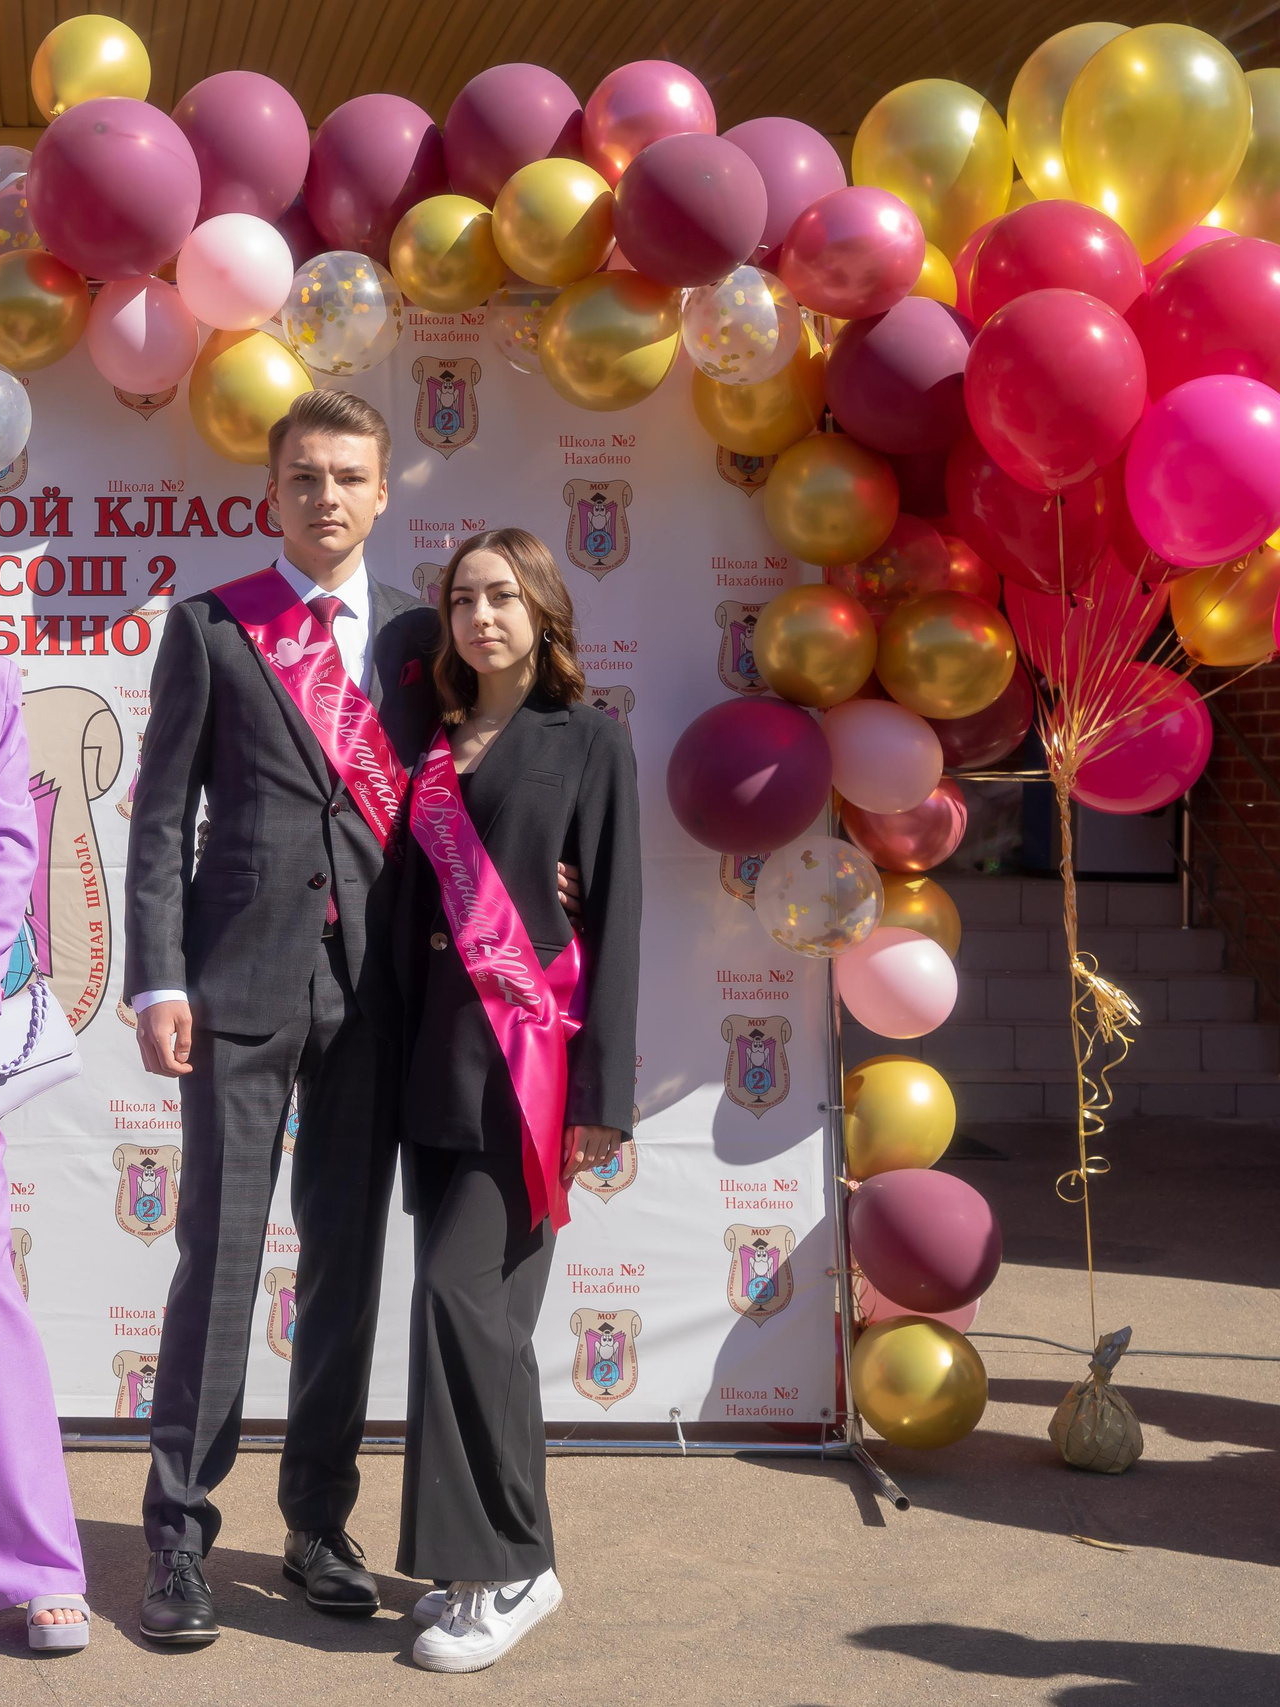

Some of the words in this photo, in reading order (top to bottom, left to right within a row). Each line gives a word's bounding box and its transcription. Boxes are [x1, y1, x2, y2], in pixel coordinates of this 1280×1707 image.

[408, 313, 455, 325] Школа
[460, 313, 485, 325] №2
[414, 330, 480, 342] Нахабино
[441, 412, 454, 430] 2
[558, 435, 607, 449] Школа
[611, 434, 636, 448] №2
[564, 453, 631, 466] Нахабино
[108, 480, 155, 492] Школа
[160, 479, 185, 492] №2
[589, 483, 610, 491] МОУ
[408, 519, 455, 531] Школа
[461, 519, 486, 531] №2
[593, 534, 606, 552] 2
[711, 557, 758, 570] Школа
[764, 556, 788, 570] №2
[147, 555, 176, 597] 2
[716, 574, 784, 587] Нахабино
[576, 643, 607, 653] кола
[612, 640, 638, 653] №2
[579, 658, 633, 670] ахабино
[354, 781, 389, 837] Нахабинская
[73, 832, 101, 910] ШКОЛА
[747, 862, 759, 881] 2
[415, 786, 500, 943] Выпускница
[480, 945, 542, 1006] 2022
[716, 970, 763, 983] Школа
[768, 970, 794, 982] №2
[722, 987, 789, 1001] Нахабино
[747, 1019, 768, 1027] МОУ
[752, 1071, 765, 1089] 2
[110, 1099, 156, 1112] Школа
[115, 1117, 182, 1130] Нахабино
[139, 1148, 160, 1156] МОУ
[10, 1182, 36, 1195] №2
[719, 1179, 768, 1192] Школа
[773, 1179, 799, 1192] №2
[142, 1199, 155, 1218] 2
[725, 1197, 794, 1210] Нахабино
[266, 1223, 299, 1236] Школ
[266, 1240, 300, 1253] Наха
[566, 1264, 614, 1277] Школа
[620, 1264, 645, 1277] №2
[571, 1281, 640, 1294] Нахабино
[755, 1280, 768, 1299] 2
[109, 1306, 156, 1319] Школа
[600, 1363, 612, 1382] 2
[720, 1387, 768, 1400] Школа
[773, 1387, 799, 1400] №2
[725, 1405, 795, 1417] Нахабино
